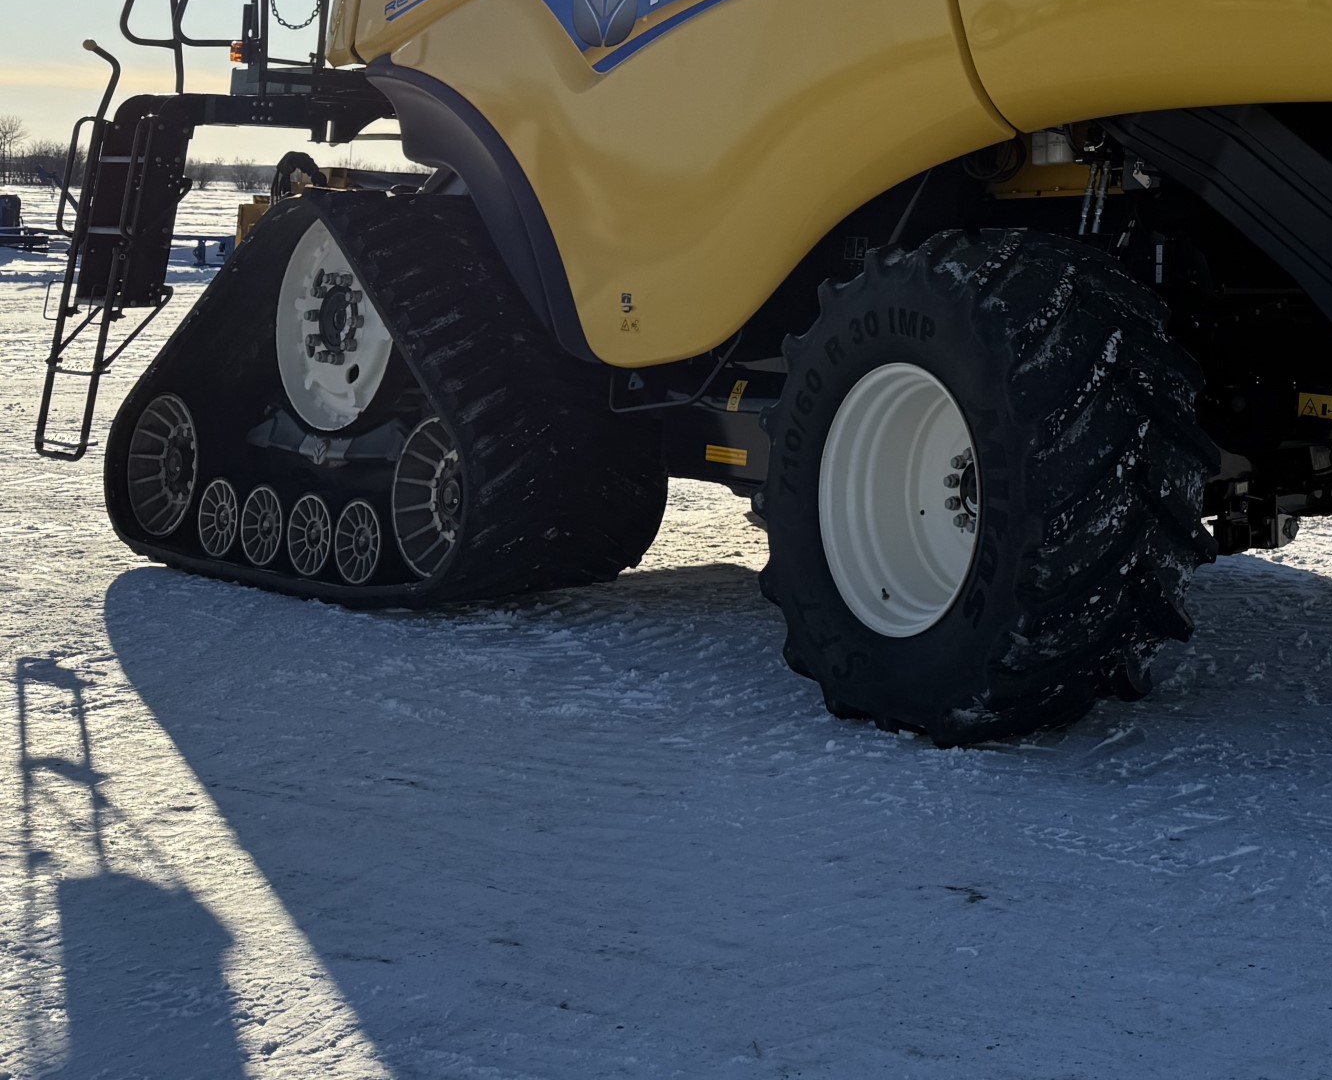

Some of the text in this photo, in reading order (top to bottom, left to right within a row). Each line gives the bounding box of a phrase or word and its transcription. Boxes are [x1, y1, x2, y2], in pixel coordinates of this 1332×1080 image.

[779, 306, 936, 497] 710/60 R 30 IMP
